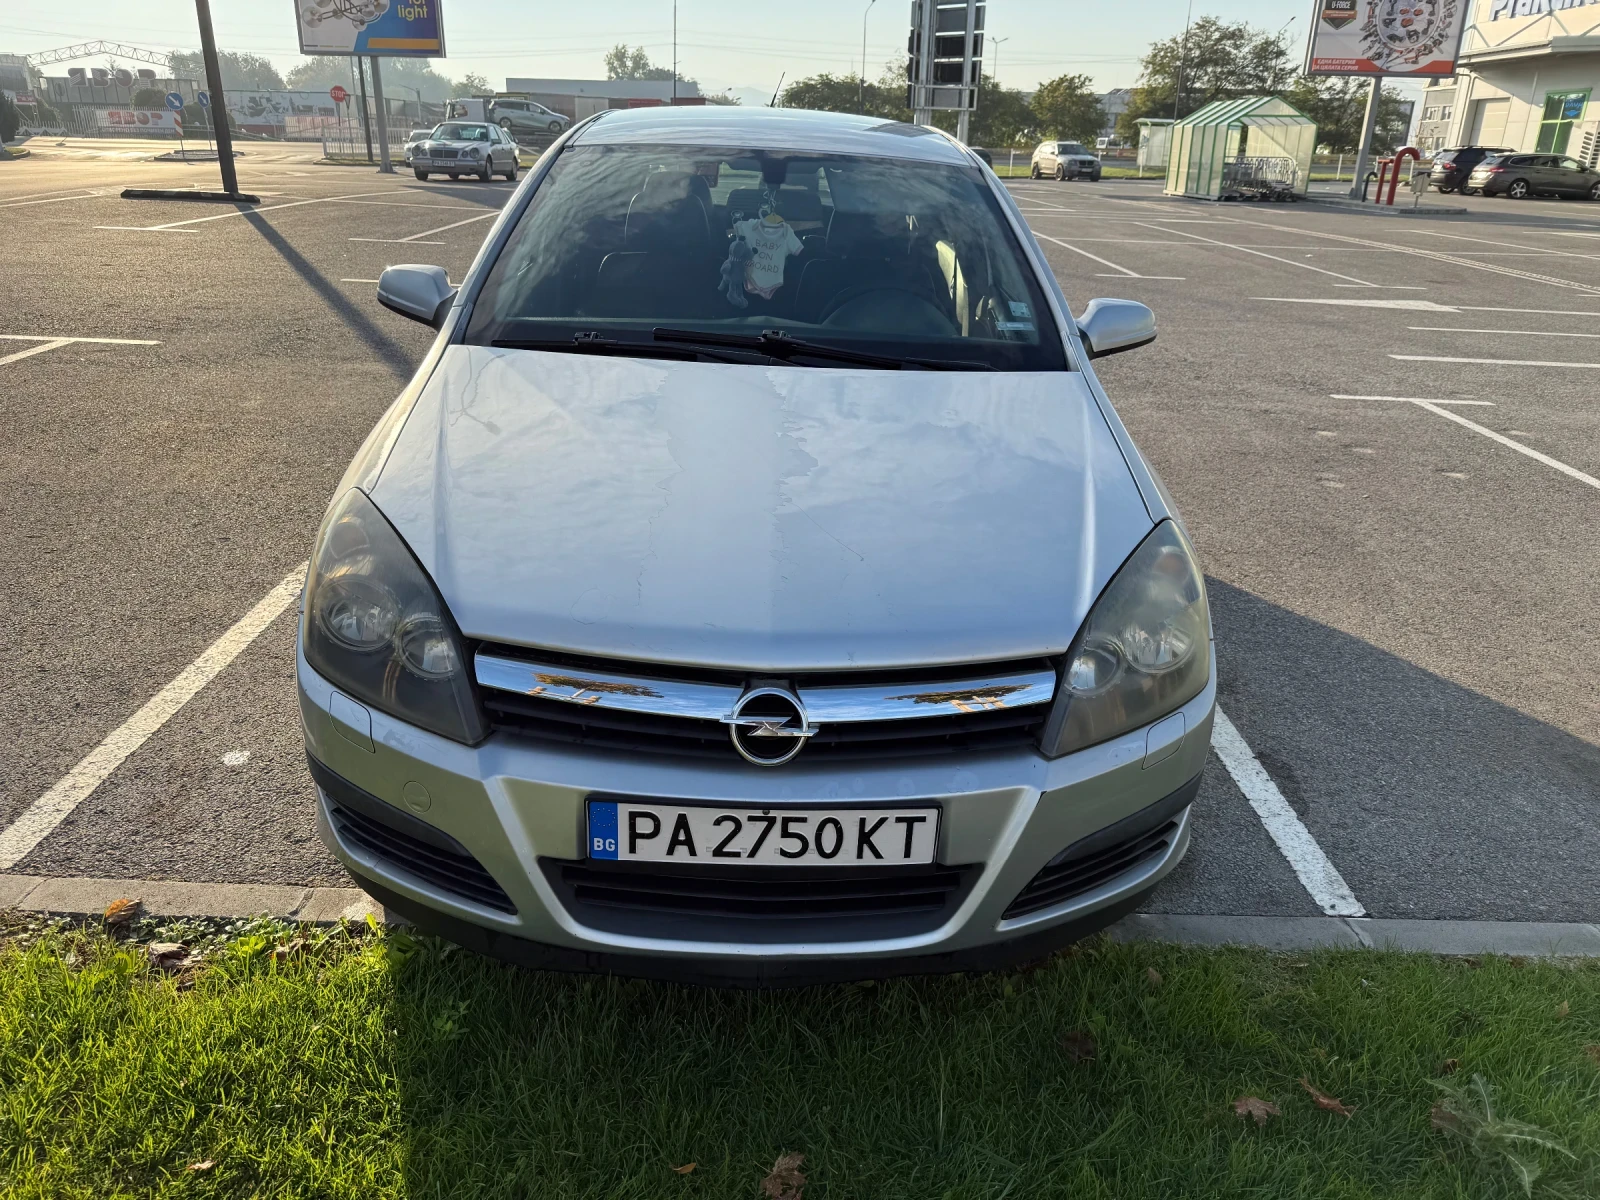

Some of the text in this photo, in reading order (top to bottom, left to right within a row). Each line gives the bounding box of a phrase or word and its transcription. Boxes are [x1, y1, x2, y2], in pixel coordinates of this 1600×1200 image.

[397, 4, 428, 21] light
[68, 67, 156, 87] ЯВОР
[331, 89, 346, 98] STOP
[756, 239, 782, 250] BABY
[759, 252, 773, 260] ON
[627, 810, 927, 860] PA 2750 KT
[593, 838, 616, 852] BG
